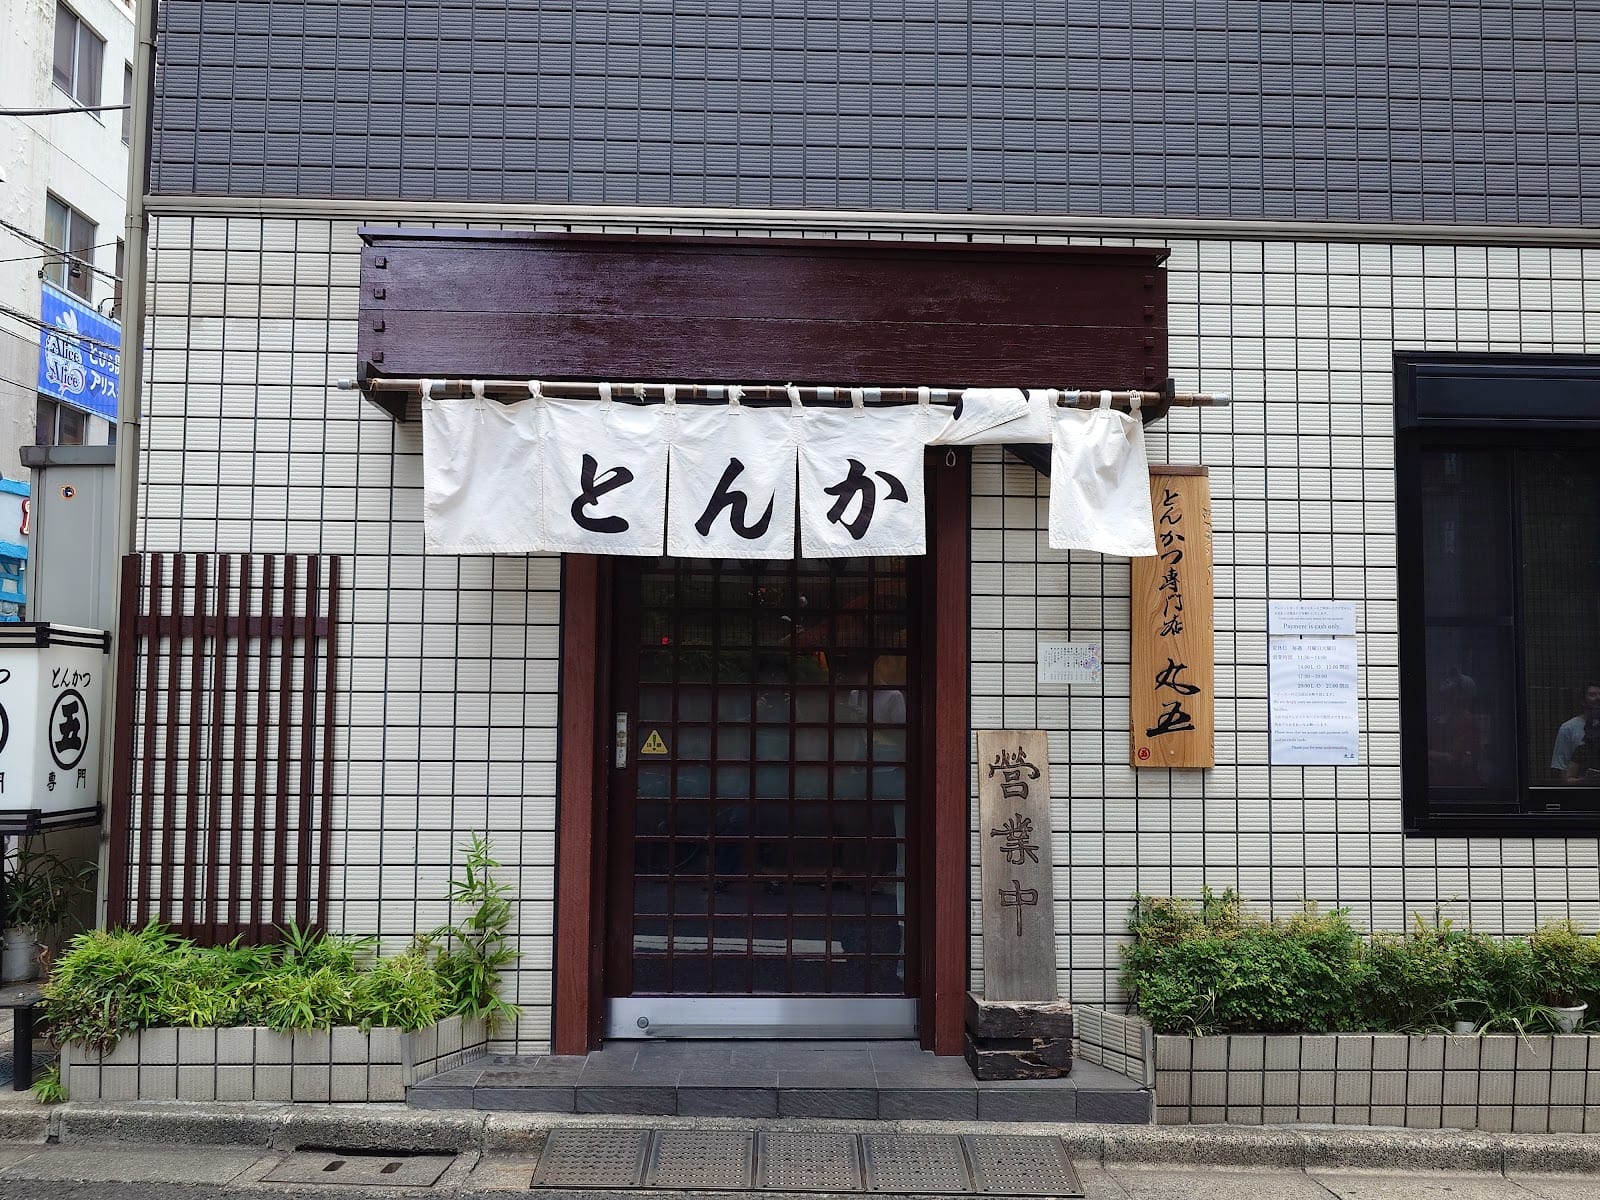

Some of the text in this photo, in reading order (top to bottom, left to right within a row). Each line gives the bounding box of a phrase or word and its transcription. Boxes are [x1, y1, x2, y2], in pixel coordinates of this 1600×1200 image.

[46, 336, 81, 364] Alice
[49, 361, 79, 388] Alice
[90, 370, 118, 399] アリス
[570, 453, 908, 540] とんか
[52, 667, 91, 688] とんかつ
